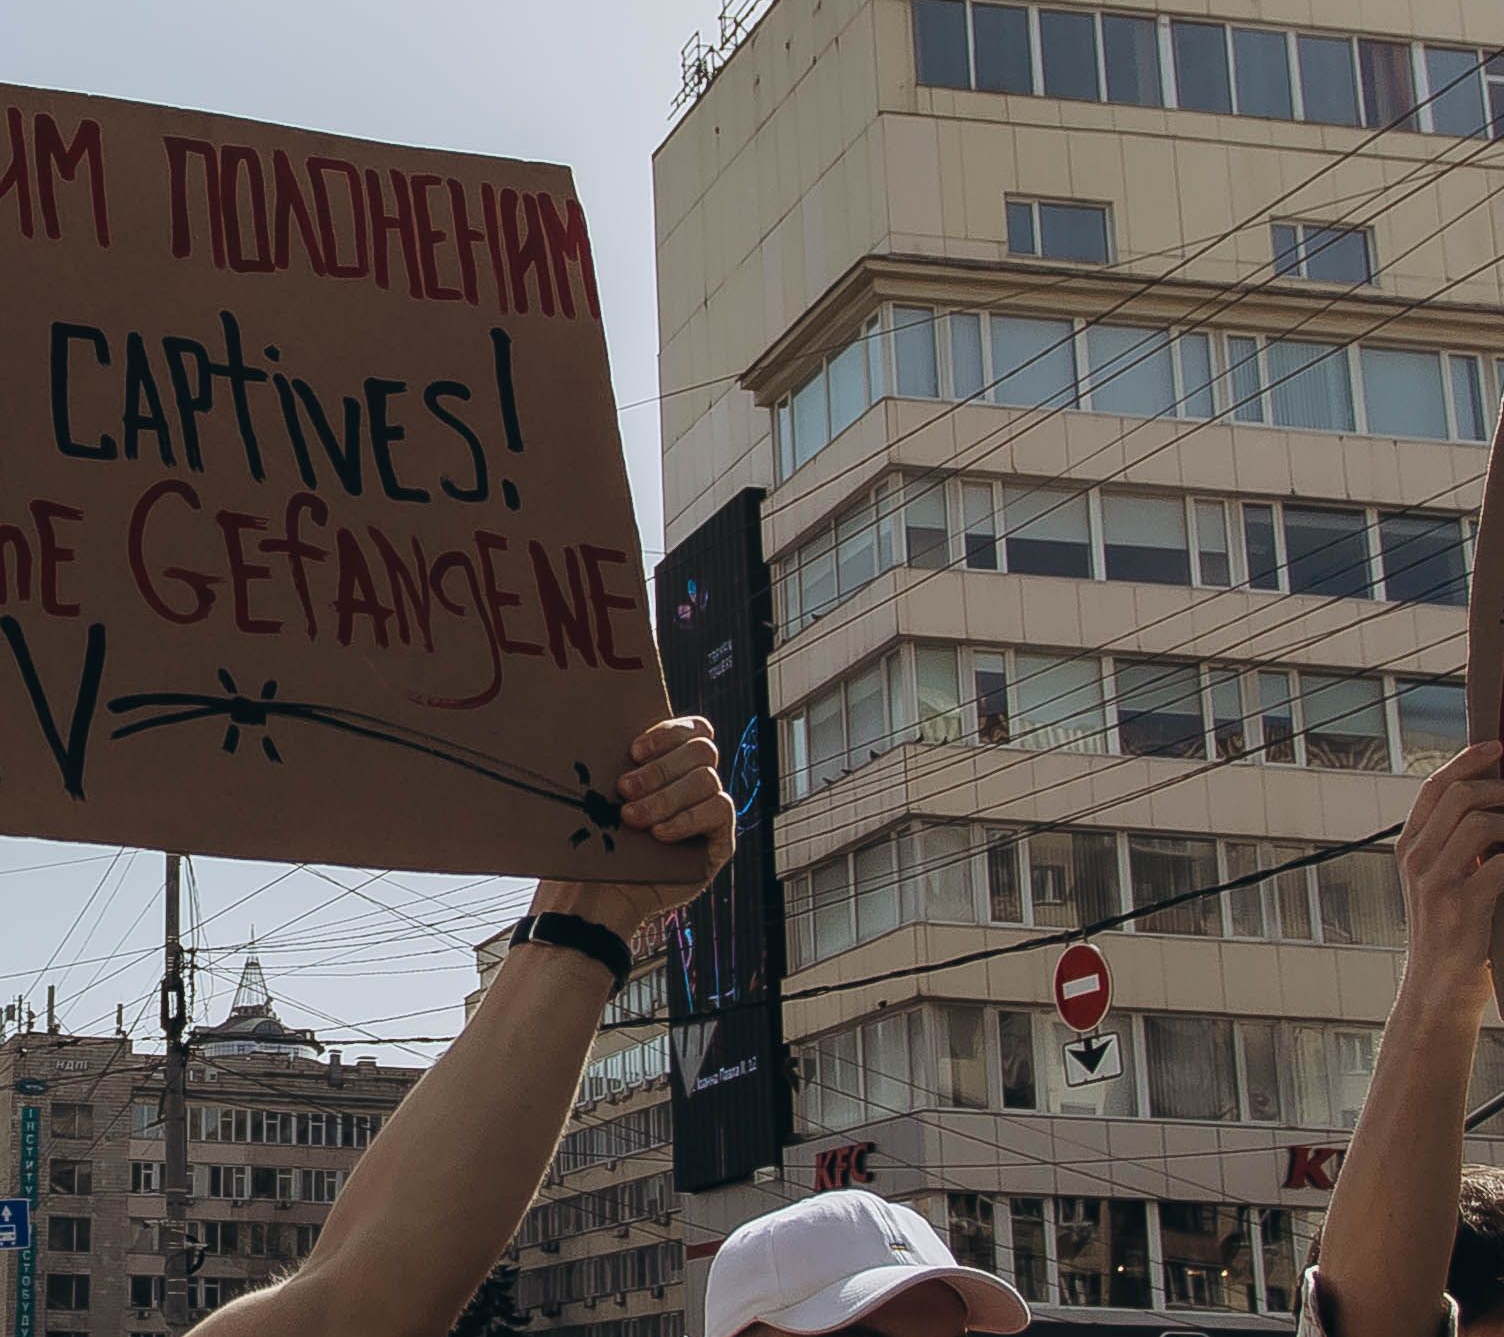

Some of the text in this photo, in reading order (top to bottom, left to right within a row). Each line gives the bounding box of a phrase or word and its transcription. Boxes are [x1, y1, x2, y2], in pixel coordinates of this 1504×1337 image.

[24, 1108, 35, 1201] ІНСТИТУ
[814, 1142, 876, 1191] KFC
[1281, 1145, 1343, 1190] K
